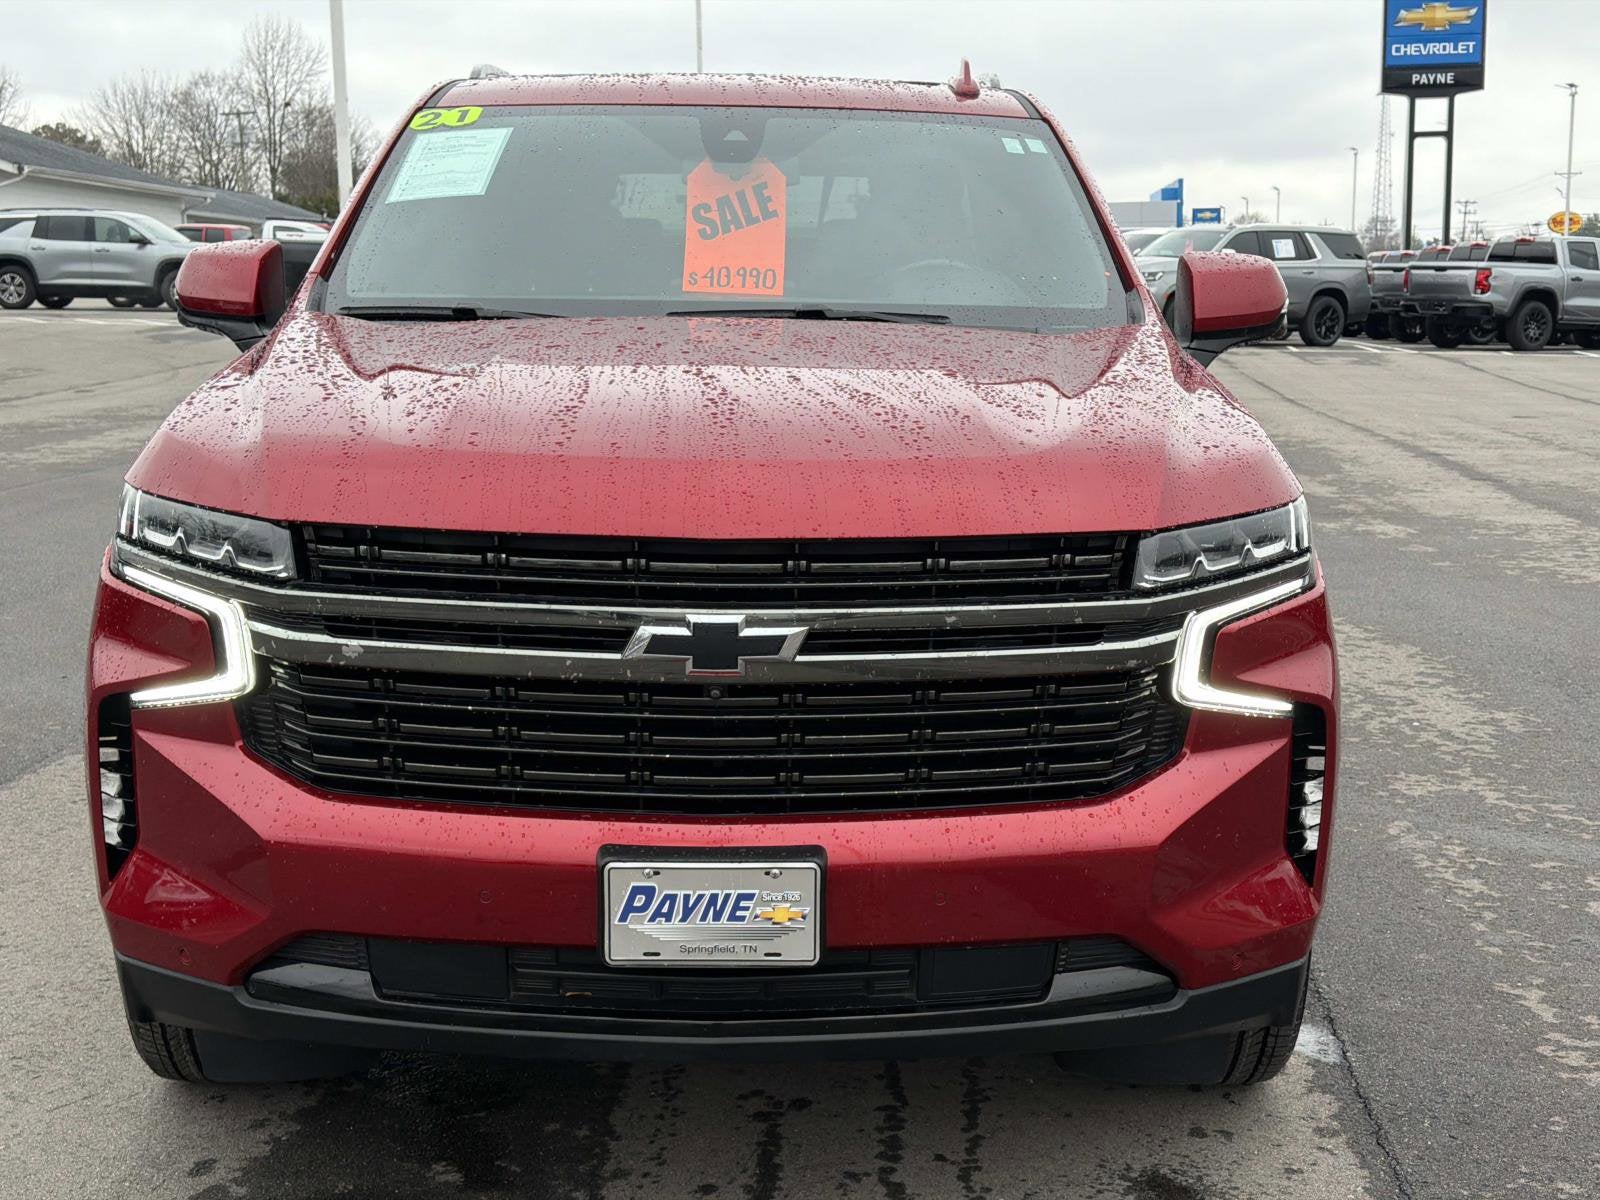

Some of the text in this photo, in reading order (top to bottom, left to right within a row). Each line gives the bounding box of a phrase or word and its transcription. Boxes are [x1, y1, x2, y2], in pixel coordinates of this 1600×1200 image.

[1391, 41, 1476, 56] CHEVROLET
[1412, 72, 1455, 85] PAYNE
[414, 109, 471, 129] 21
[691, 181, 779, 241] SALE
[762, 892, 782, 901] Since
[679, 944, 758, 955] Springfield, TN
